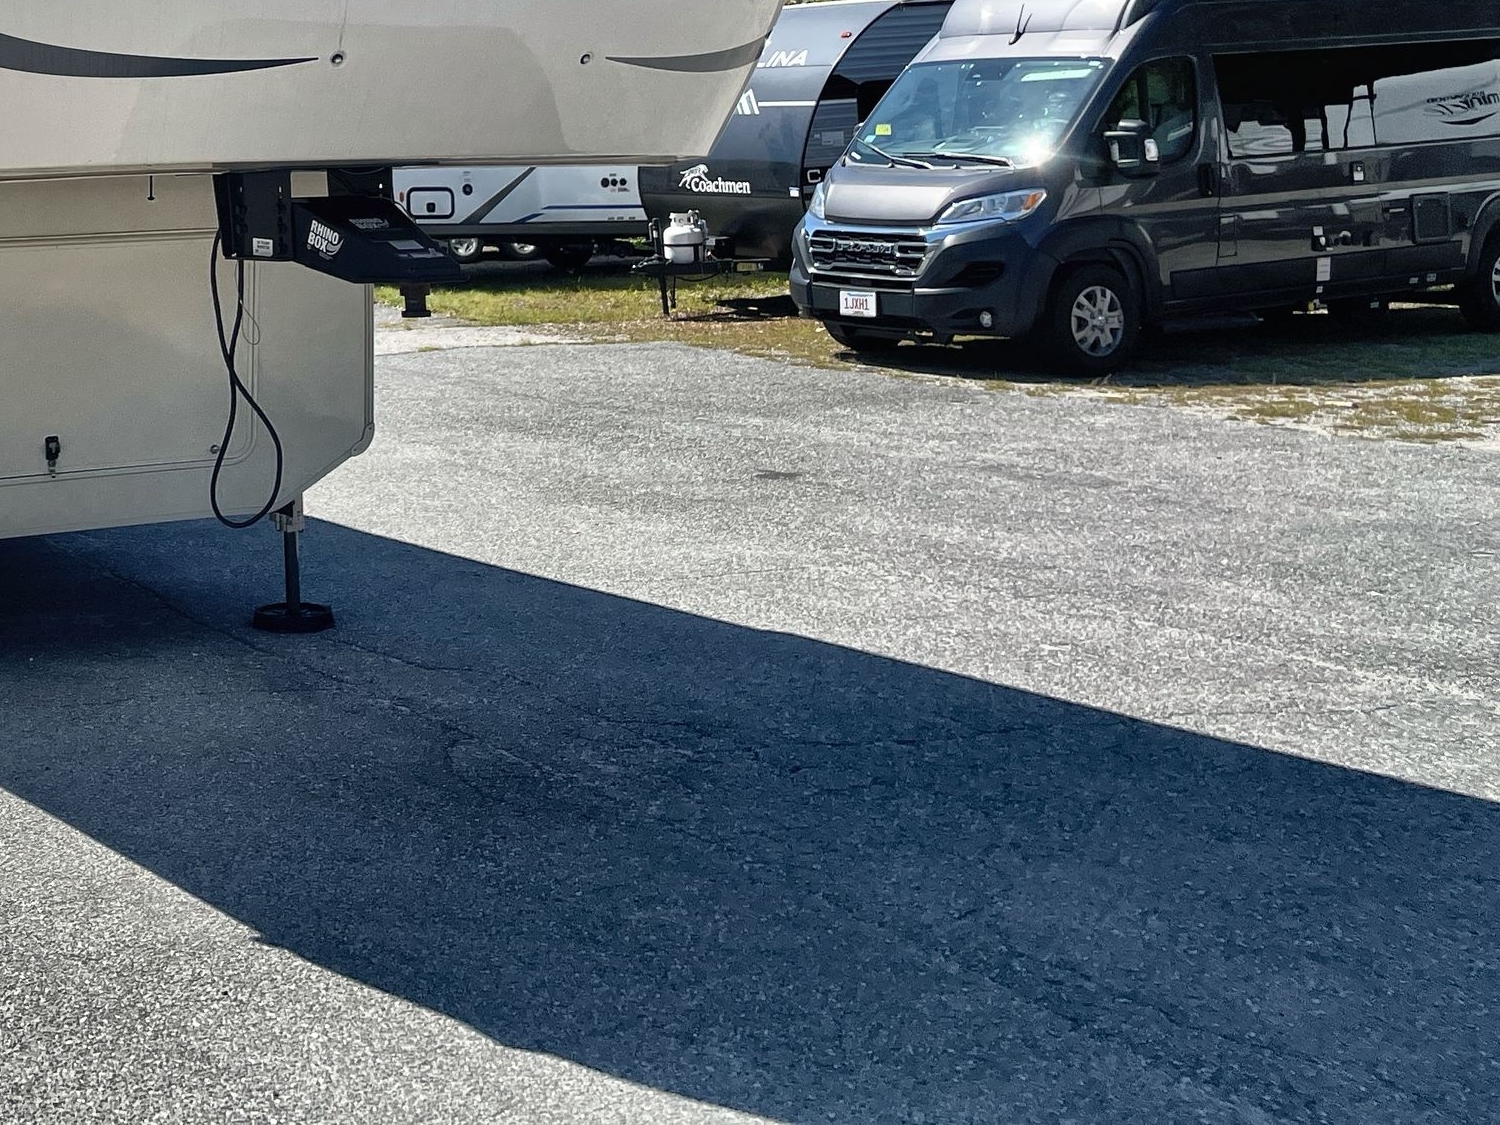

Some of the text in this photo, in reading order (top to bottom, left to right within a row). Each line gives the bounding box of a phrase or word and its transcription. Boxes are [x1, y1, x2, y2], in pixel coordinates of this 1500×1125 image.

[690, 177, 752, 194] Coachmen
[307, 231, 329, 253] BOX
[310, 219, 340, 245] RHINO
